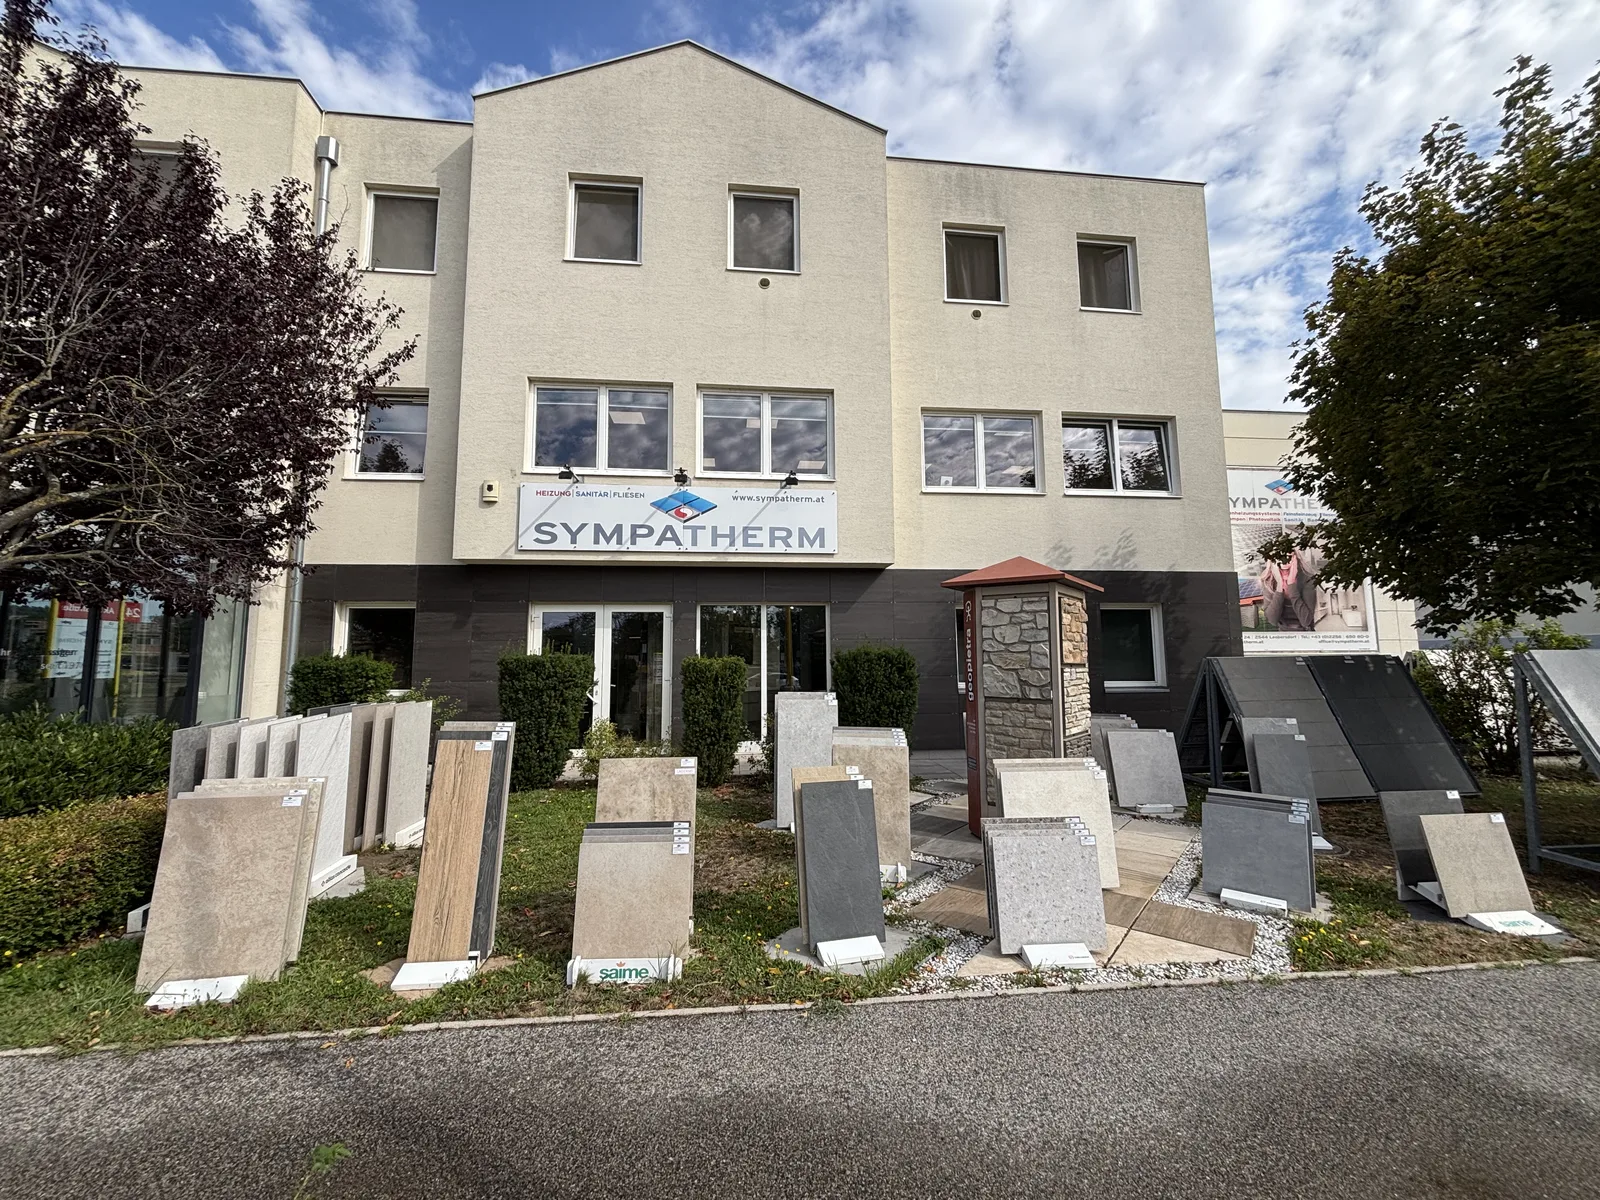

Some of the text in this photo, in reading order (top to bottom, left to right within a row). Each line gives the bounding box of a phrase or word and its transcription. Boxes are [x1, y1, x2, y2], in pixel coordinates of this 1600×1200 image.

[612, 491, 645, 499] FLIESEN
[731, 494, 825, 504] www.sympatherm.at
[1229, 497, 1322, 509] YMPATHE
[533, 521, 826, 549] SYMPATHERM
[599, 967, 649, 980] saime
